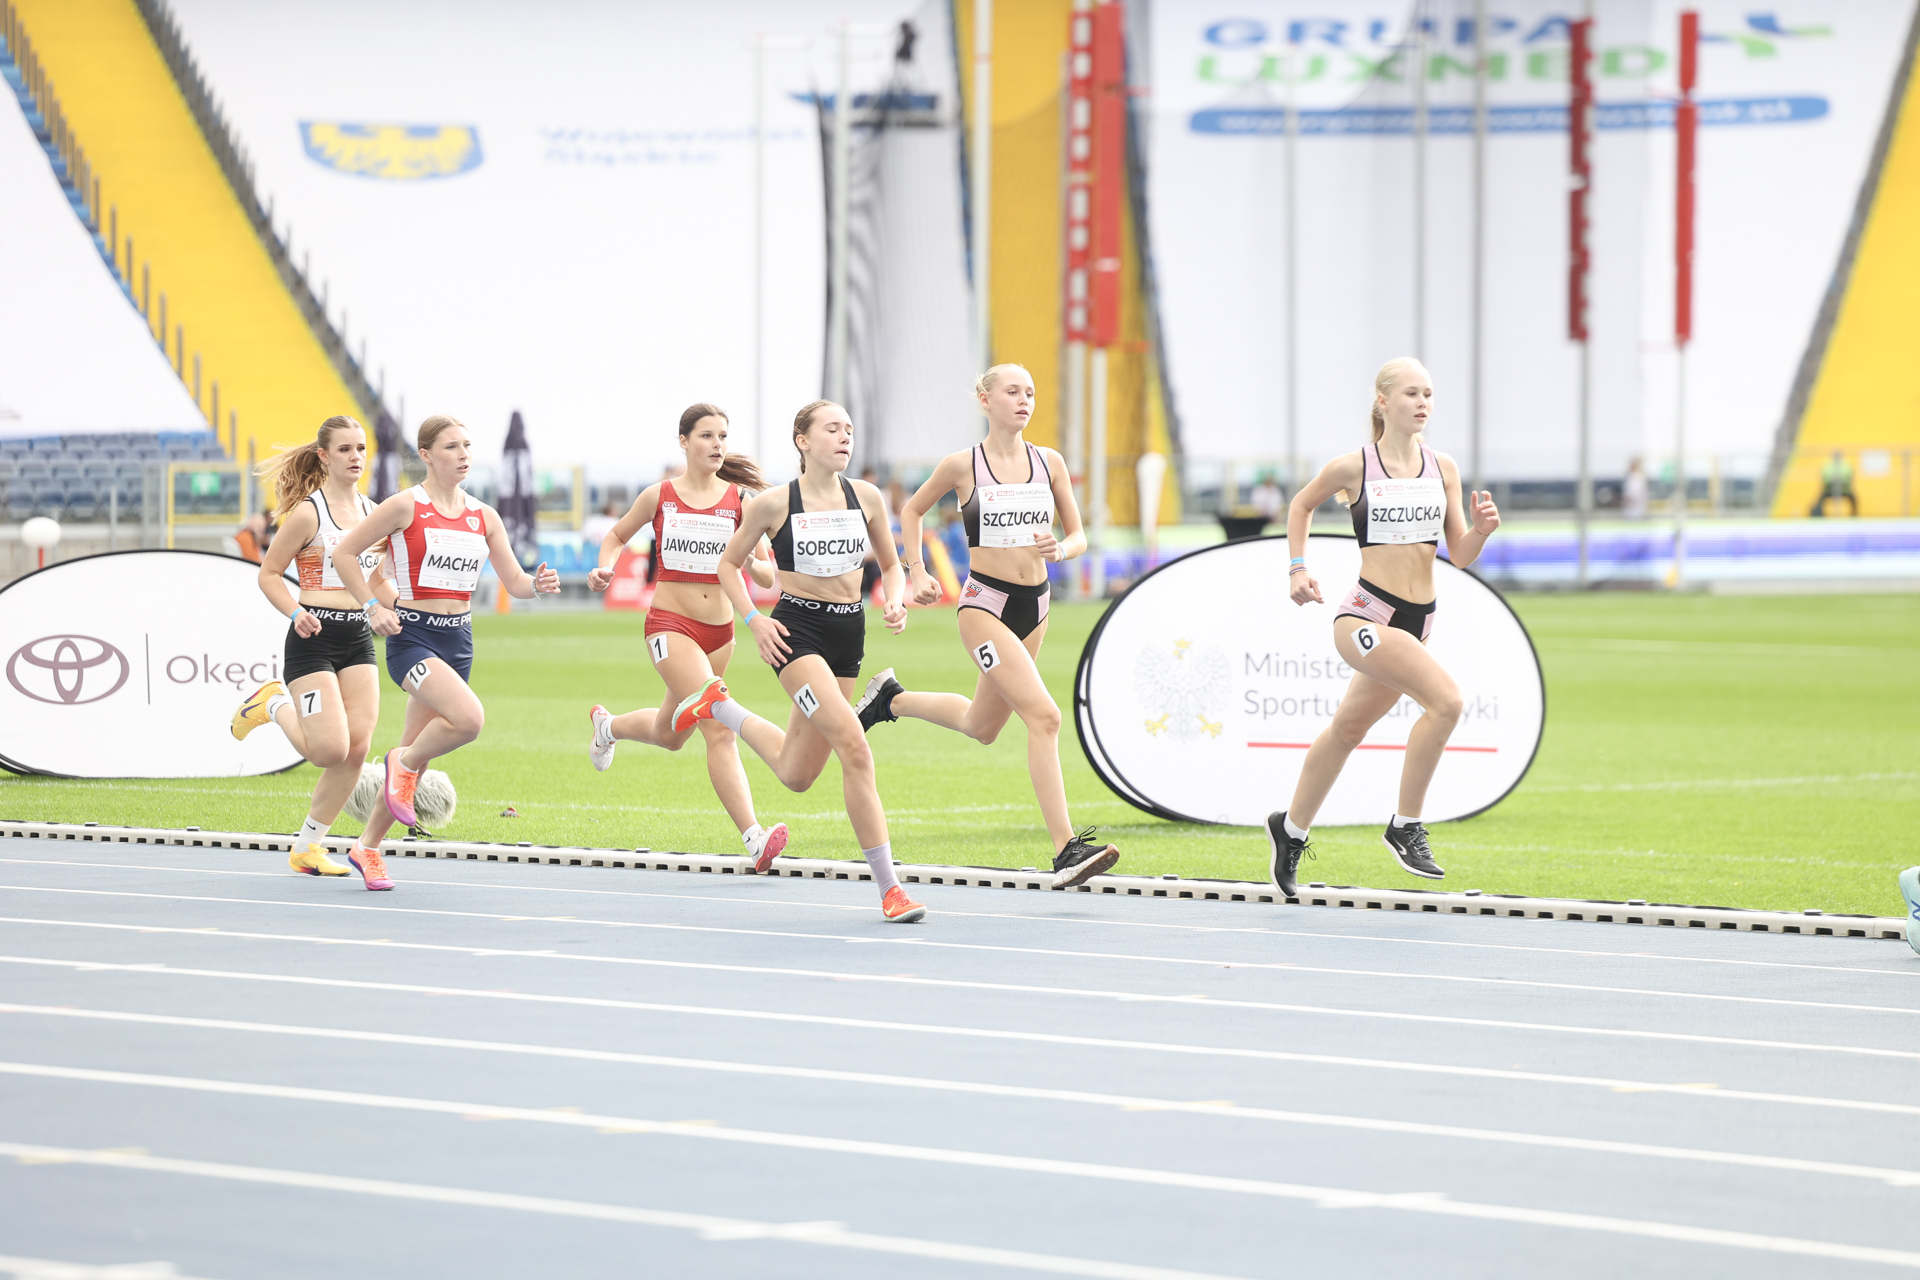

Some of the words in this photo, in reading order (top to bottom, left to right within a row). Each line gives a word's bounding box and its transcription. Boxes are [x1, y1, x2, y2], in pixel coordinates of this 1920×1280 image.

[1203, 16, 1574, 46] GRUPA
[983, 511, 1050, 528] SZCZUCKA
[1371, 505, 1442, 523] SZCZUCKA
[664, 538, 727, 555] JAWORSKA
[797, 538, 865, 556] SOBCZUK
[328, 554, 379, 569] TAGA
[427, 554, 479, 572] MACHA
[780, 593, 821, 610] PRO
[826, 602, 861, 614] NIKE
[308, 608, 346, 621] NIKE
[426, 615, 460, 628] NIKE
[654, 637, 662, 659] 1
[1358, 628, 1374, 650] 6
[978, 644, 994, 668] 5
[1244, 652, 1351, 679] Ministe
[409, 661, 427, 684] 10
[304, 692, 316, 713] 7
[798, 688, 816, 712] 11
[1244, 690, 1339, 720] Sportu
